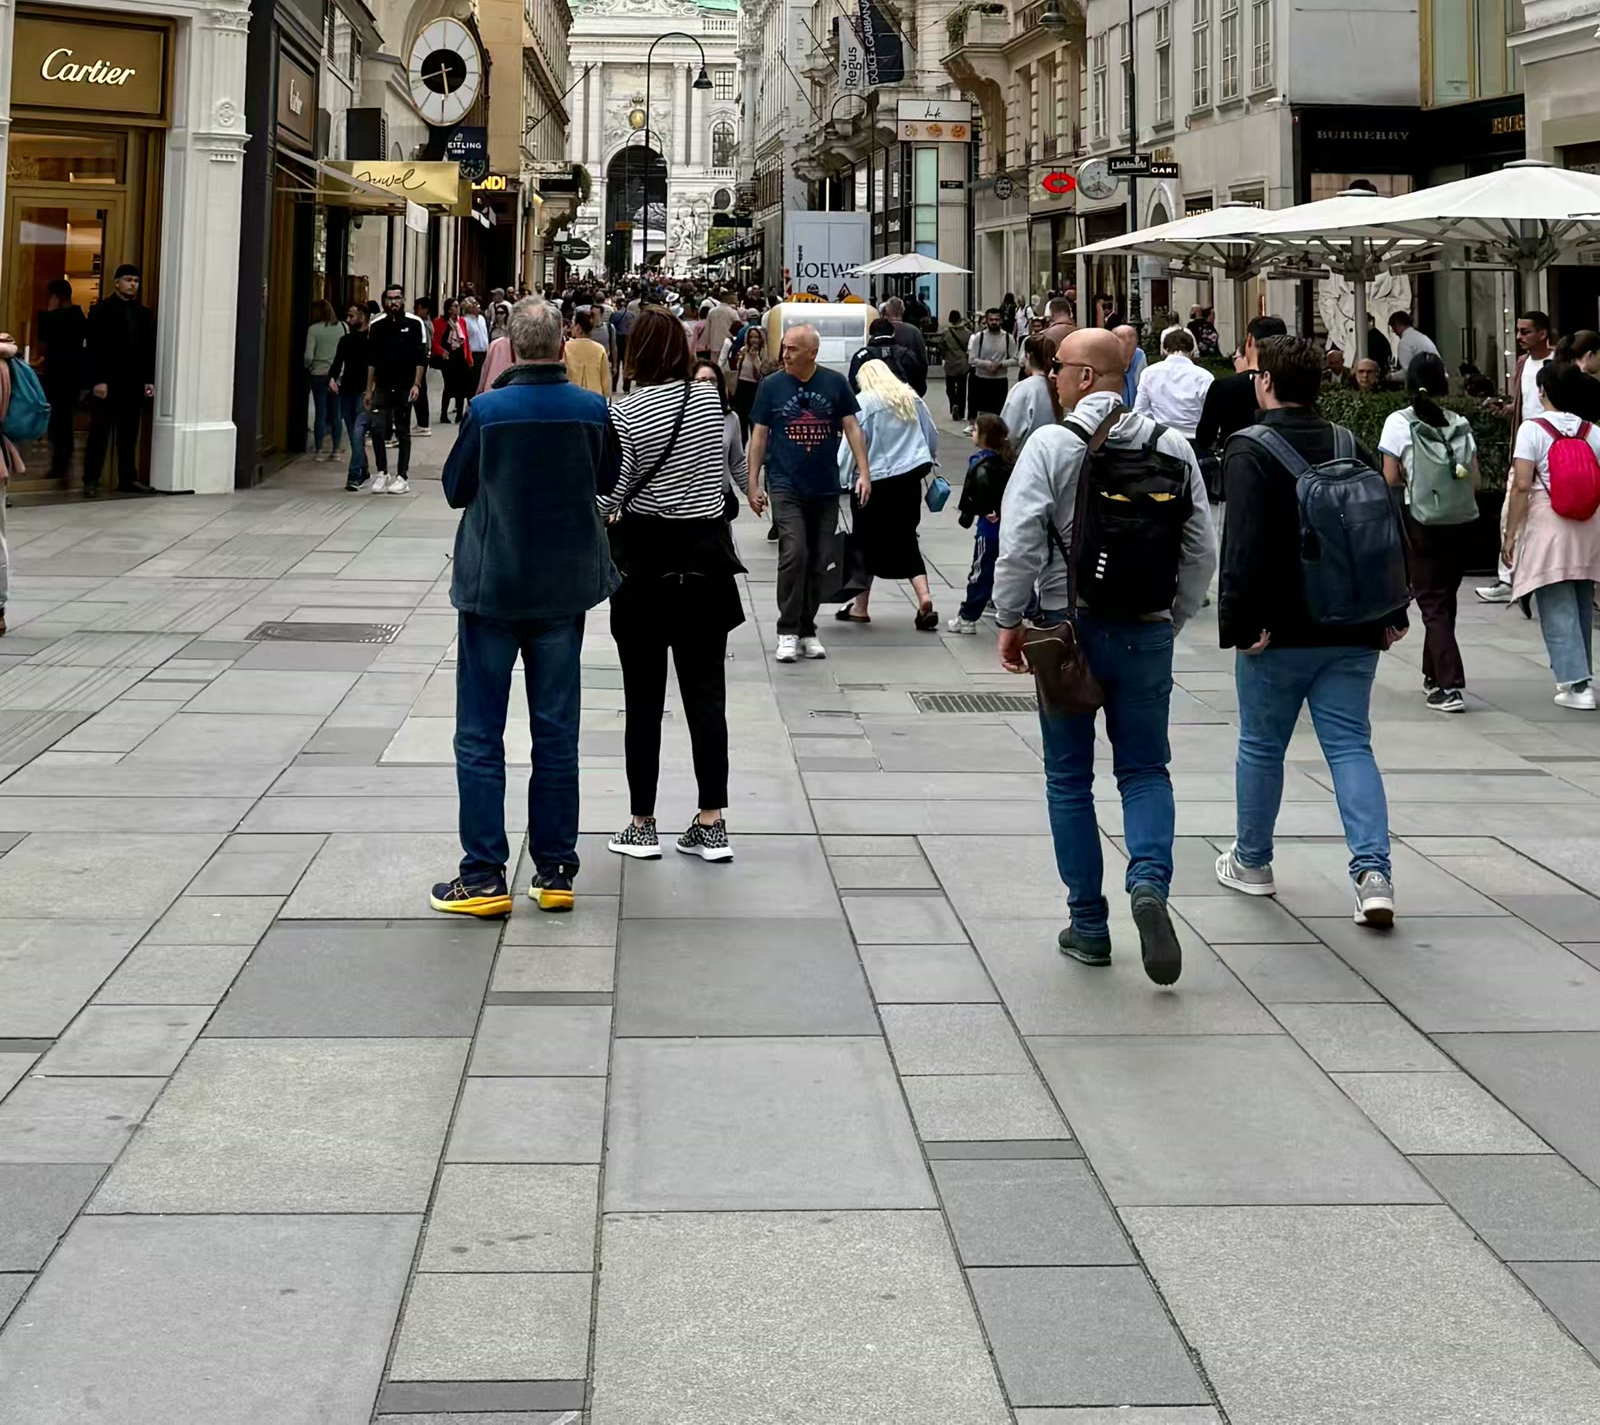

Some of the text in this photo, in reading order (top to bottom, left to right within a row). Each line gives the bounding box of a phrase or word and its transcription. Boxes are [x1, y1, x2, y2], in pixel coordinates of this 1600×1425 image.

[41, 47, 136, 86] Cartier
[845, 46, 863, 86] Regus
[1316, 130, 1411, 141] BURBERRY
[447, 141, 482, 149] EITLING
[1151, 166, 1177, 174] GARI
[471, 175, 507, 191] NDI
